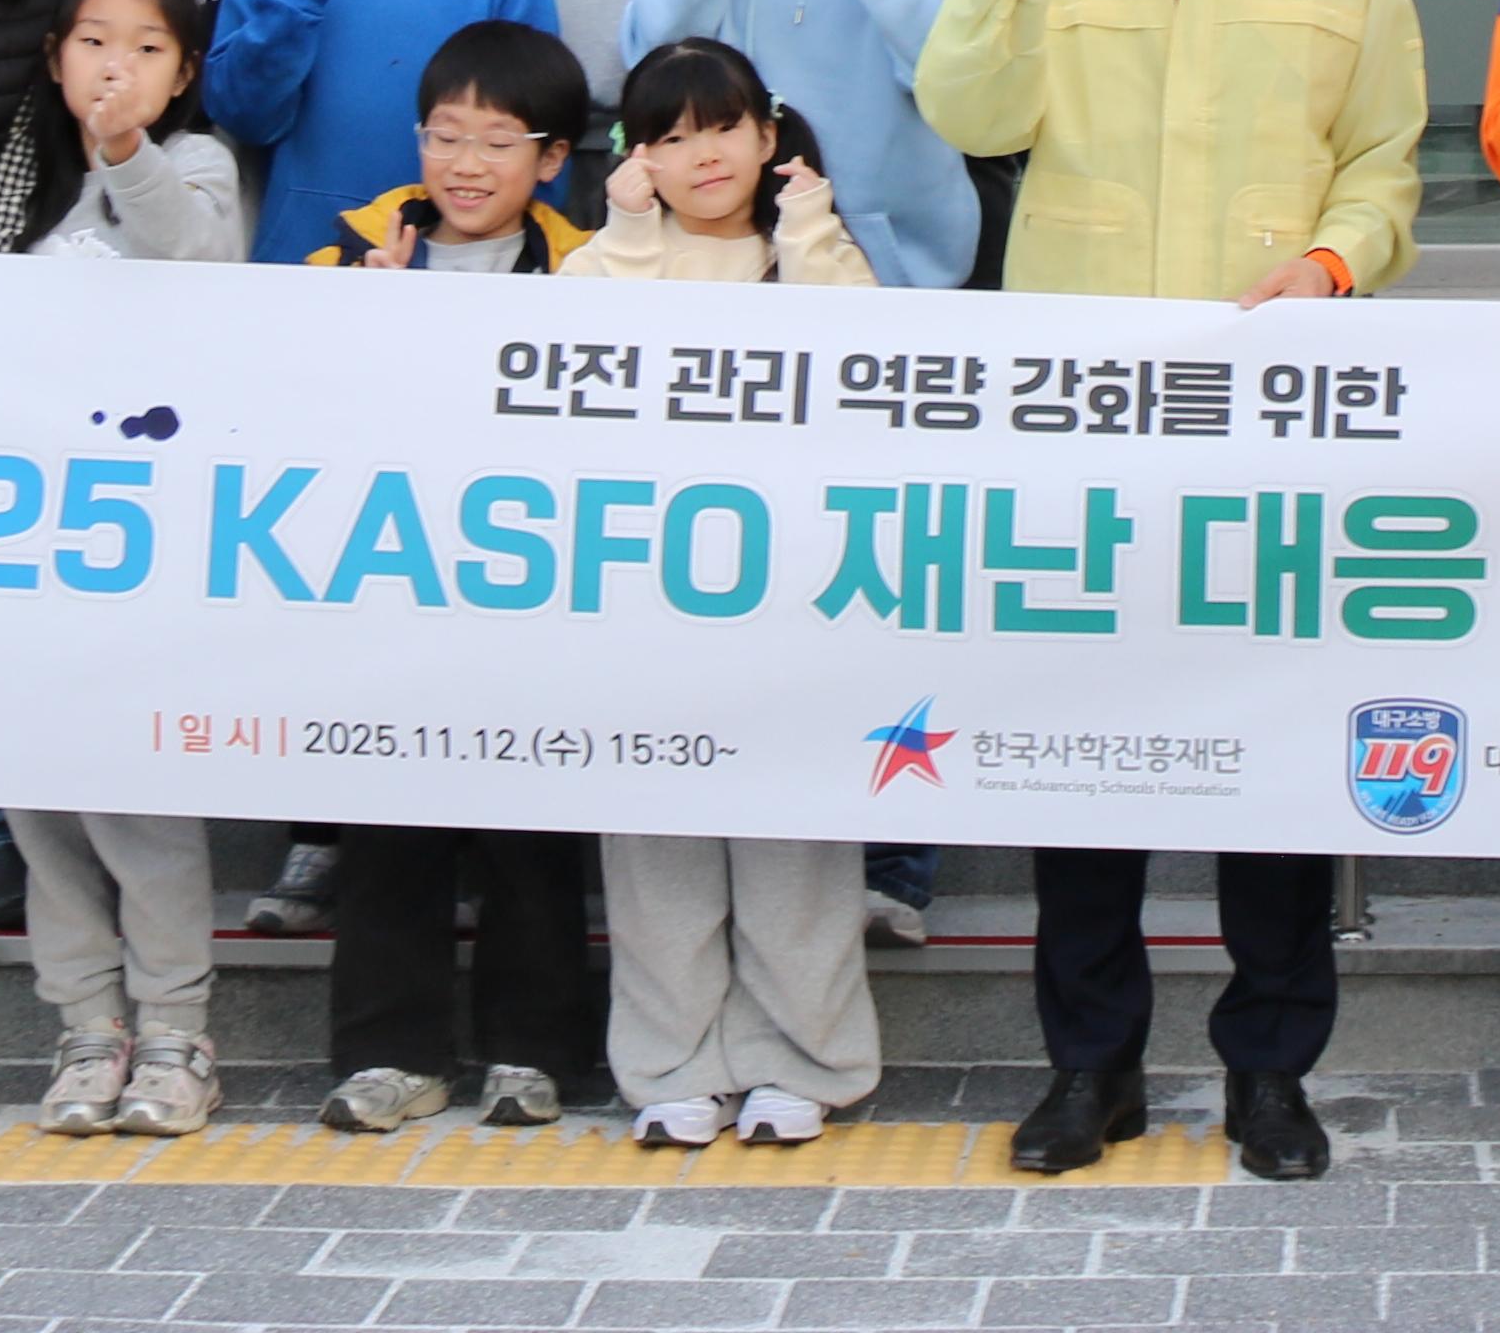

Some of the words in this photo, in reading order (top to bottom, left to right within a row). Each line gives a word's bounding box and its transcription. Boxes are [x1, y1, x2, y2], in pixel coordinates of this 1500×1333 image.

[495, 342, 640, 419] 안전
[667, 348, 810, 425] 관리
[839, 354, 985, 430] 역량
[1011, 358, 1232, 436] 강화를
[1260, 365, 1406, 439] 위한
[207, 465, 771, 618] KASFO
[812, 483, 1133, 634] 재난
[1179, 492, 1486, 640] 대응
[303, 721, 594, 767] 2025.11.12.(수)
[611, 732, 739, 767] 15:30~
[972, 730, 1246, 774] 한국사학진흥재단
[1356, 733, 1457, 796] 119
[975, 778, 1018, 792] Korea
[1021, 779, 1096, 796] Advancing
[1099, 780, 1156, 795] Schools
[1159, 782, 1242, 797] Foundation
